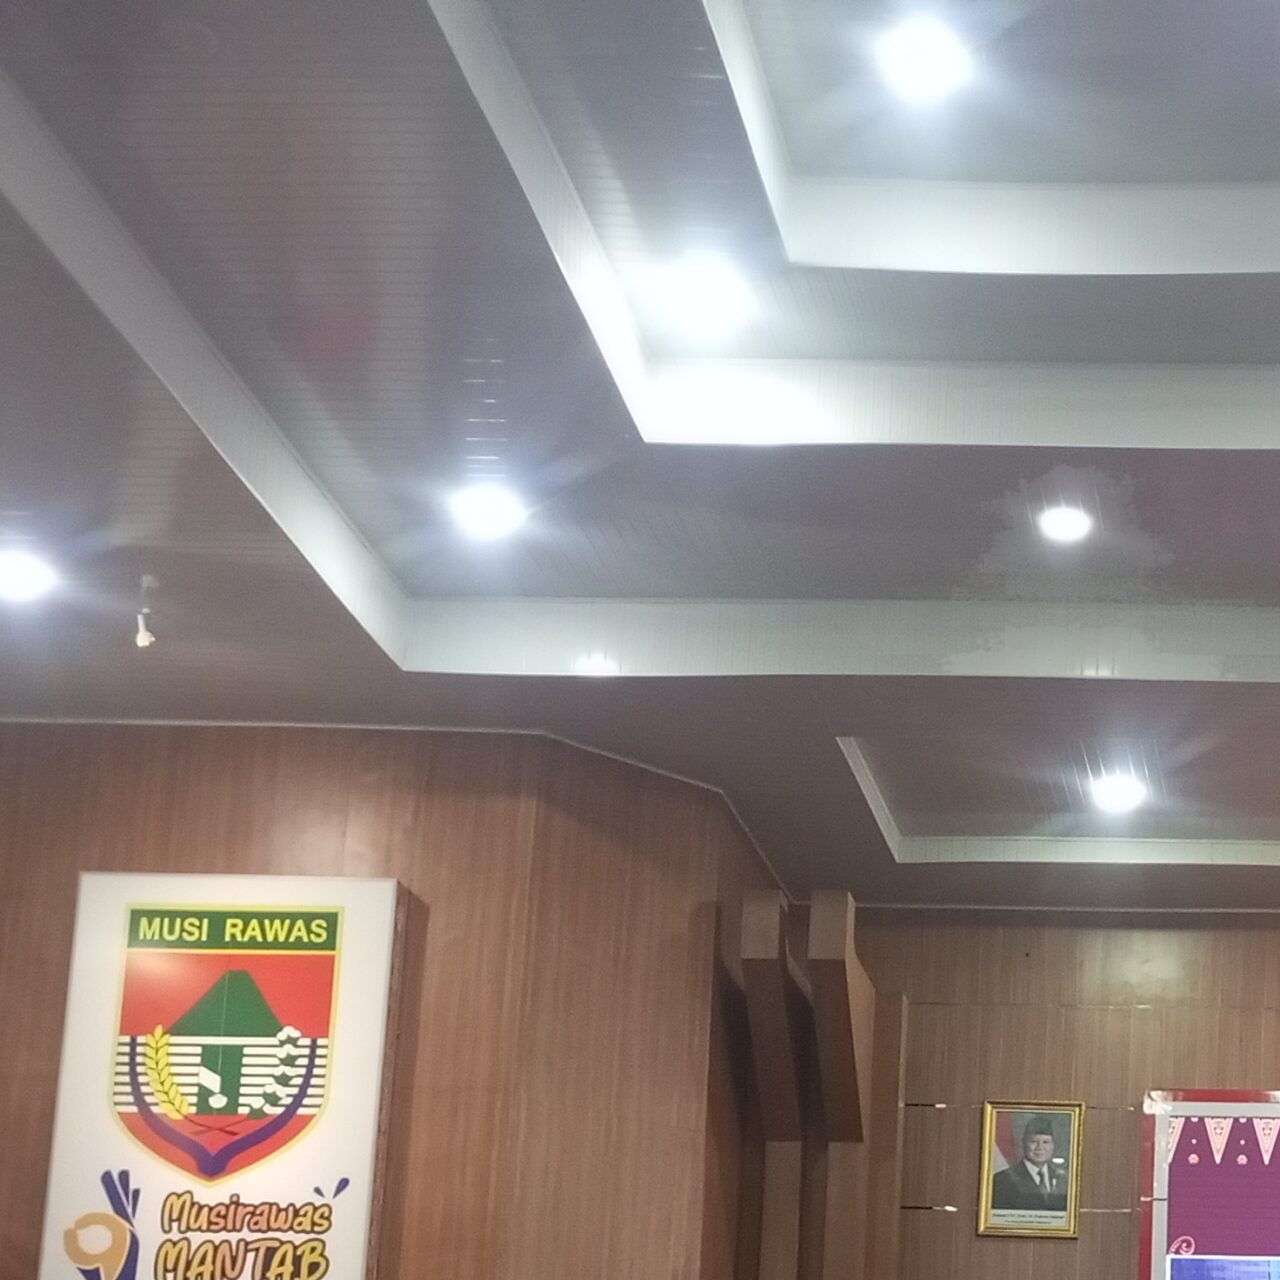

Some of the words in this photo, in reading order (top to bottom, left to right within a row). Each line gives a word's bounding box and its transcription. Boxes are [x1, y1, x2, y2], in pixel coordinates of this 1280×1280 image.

[138, 916, 209, 942] MUSI
[224, 918, 328, 943] RAWAS
[161, 1190, 333, 1234] Musirawas
